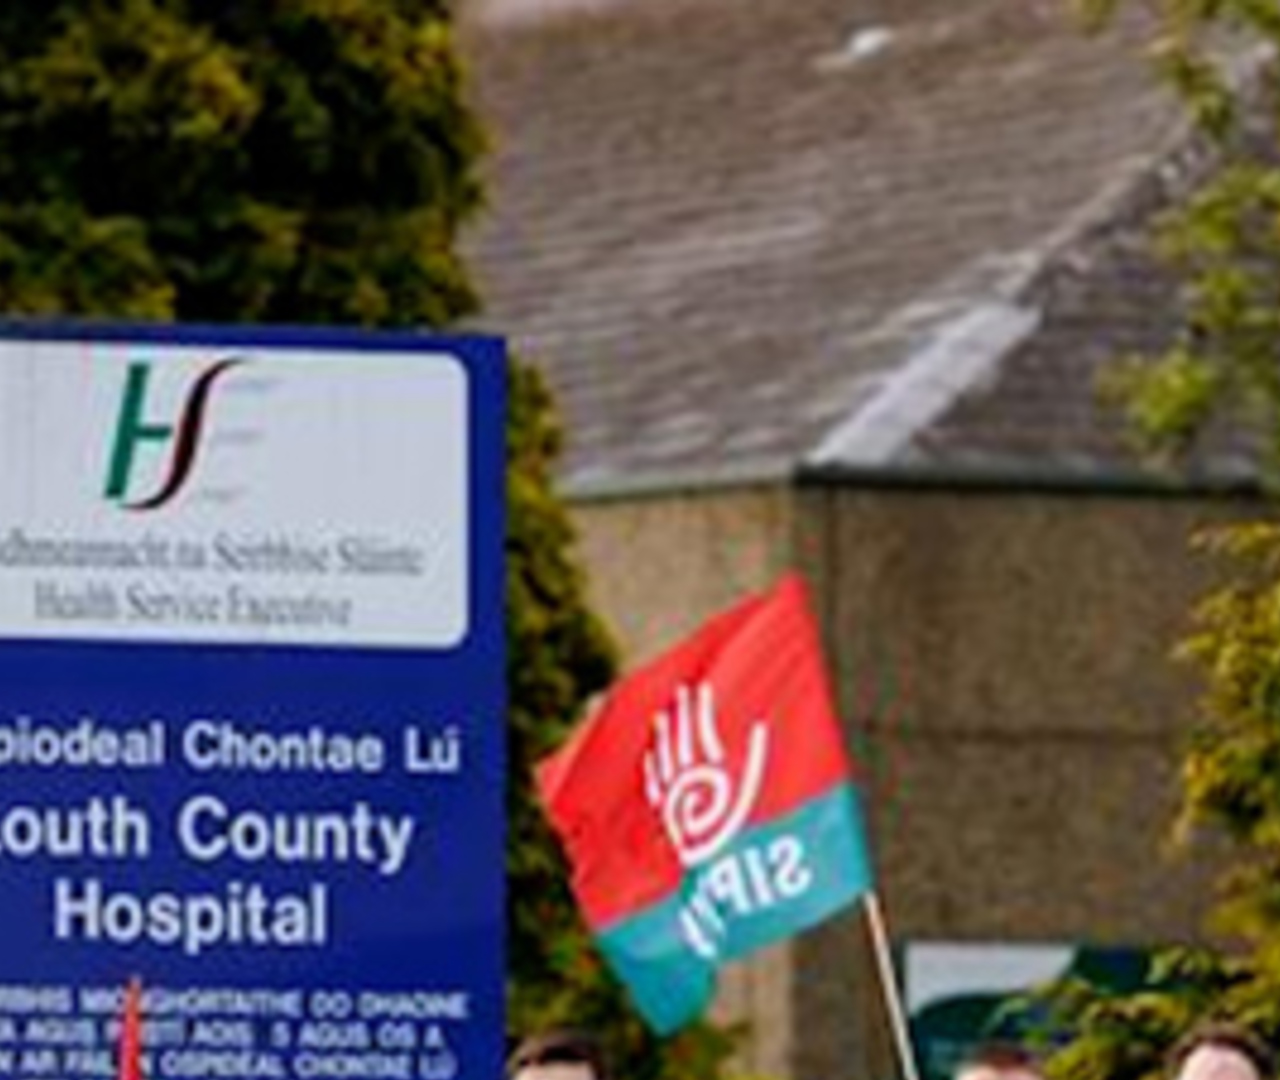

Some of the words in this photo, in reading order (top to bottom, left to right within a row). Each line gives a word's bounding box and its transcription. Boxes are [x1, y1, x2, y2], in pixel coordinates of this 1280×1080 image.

[34, 579, 118, 621] Health
[125, 582, 220, 624] Service
[226, 584, 352, 627] Executive
[182, 718, 384, 772] Chontae
[177, 794, 416, 876] County
[52, 877, 327, 957] Hospital
[308, 988, 353, 1018] DO
[24, 1016, 97, 1046] AGUS
[298, 1019, 370, 1050] AGUS
[424, 1022, 446, 1050] A
